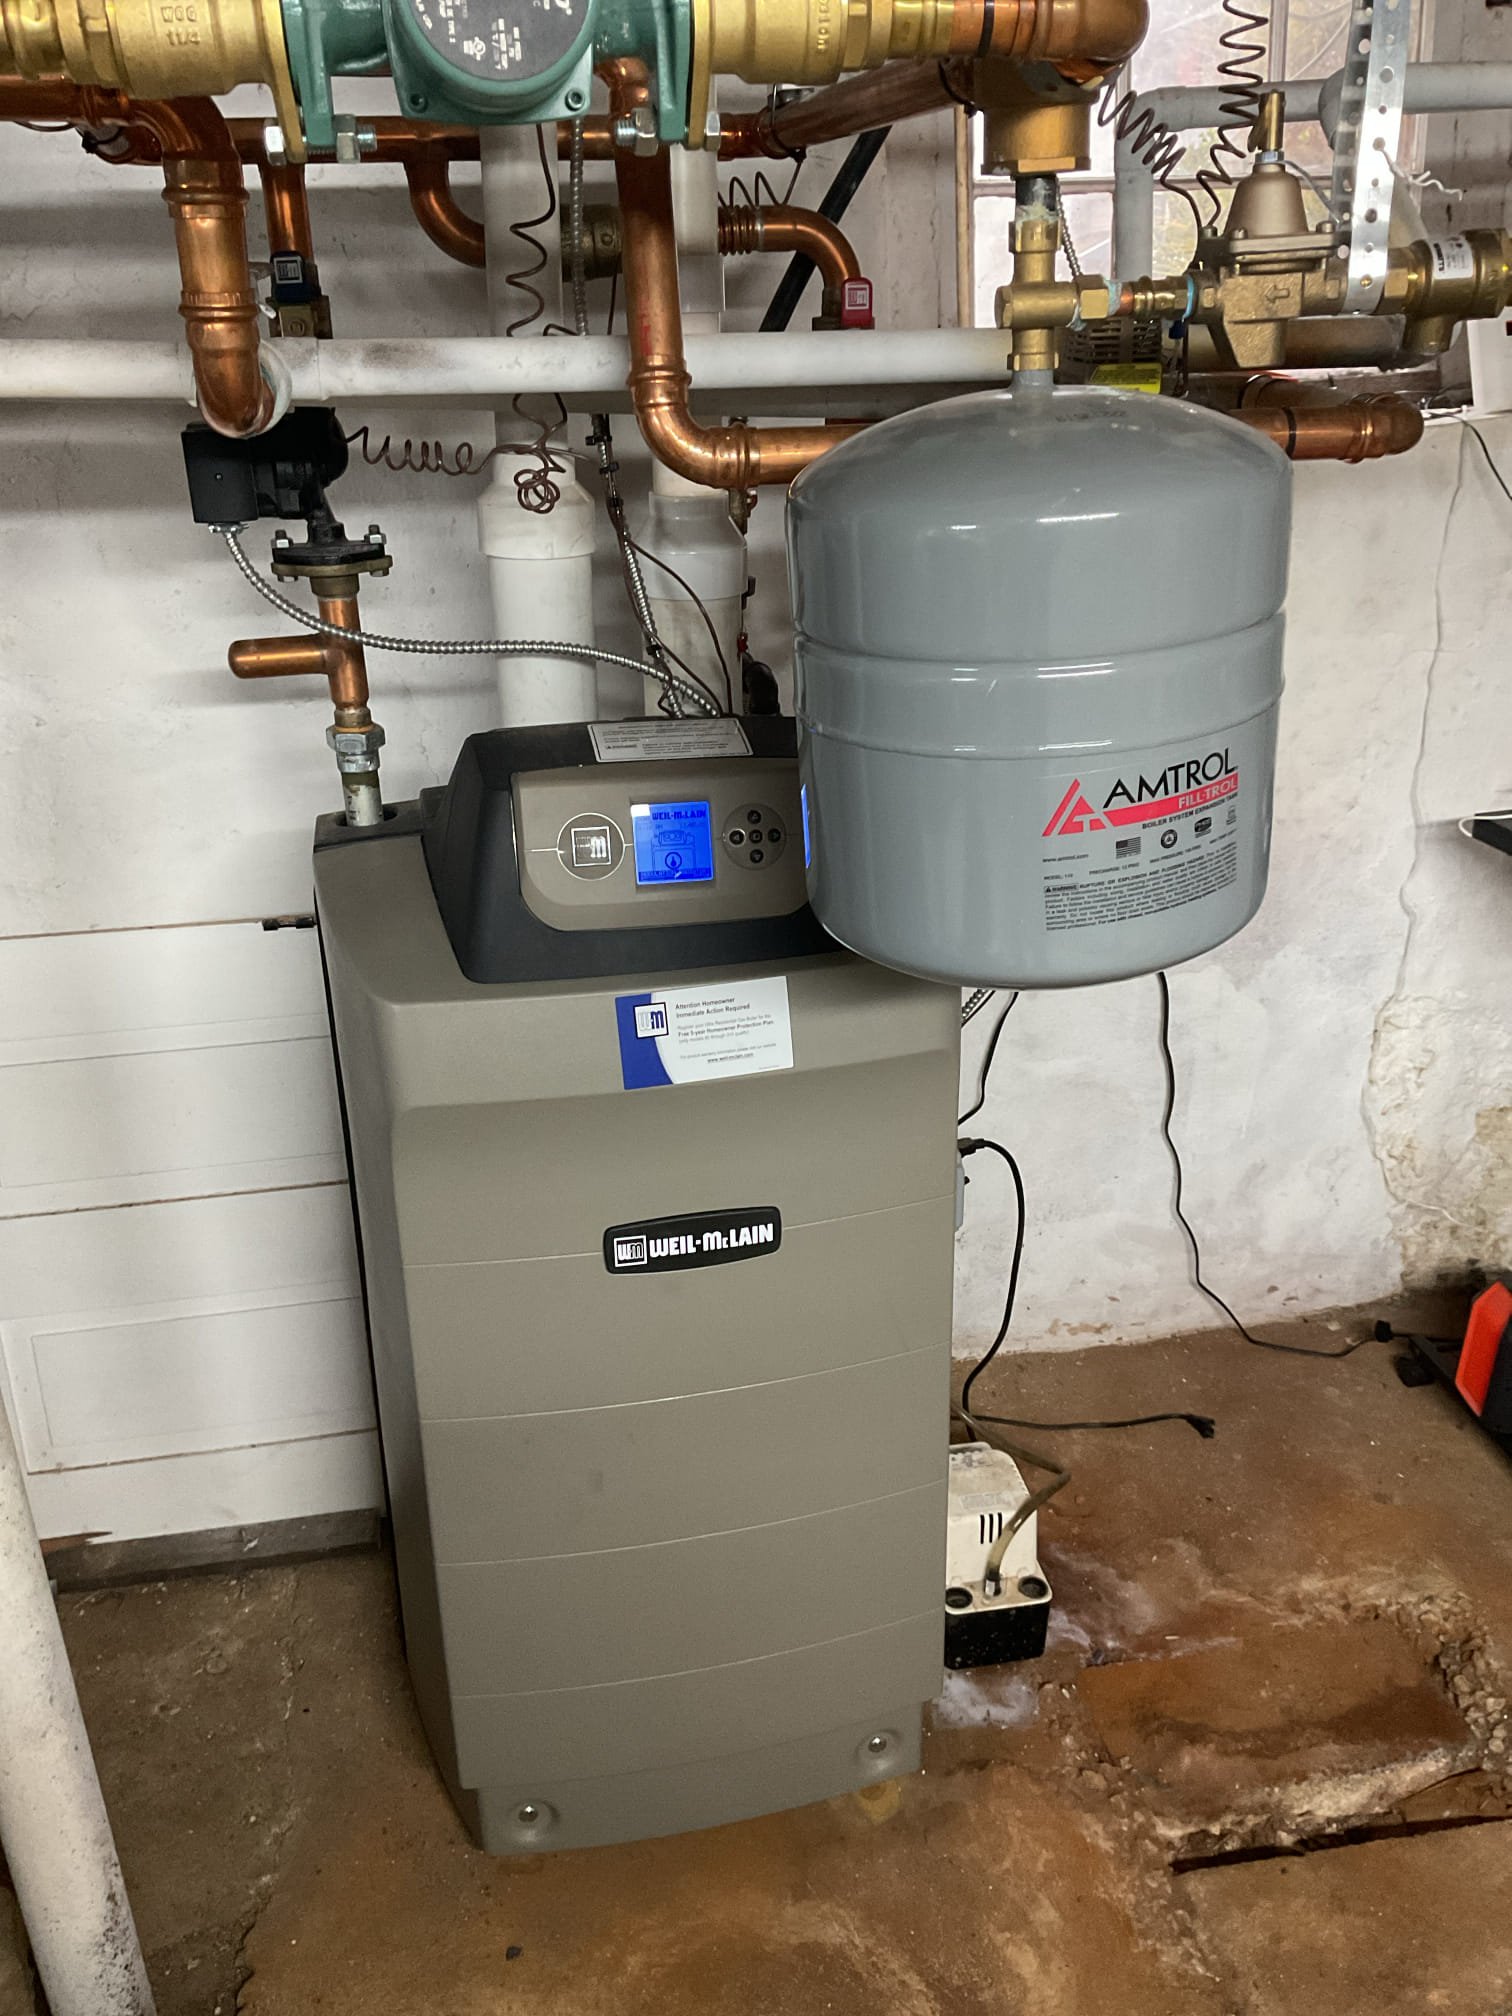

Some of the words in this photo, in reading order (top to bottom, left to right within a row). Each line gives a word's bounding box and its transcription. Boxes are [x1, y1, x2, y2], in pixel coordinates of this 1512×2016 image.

[1103, 747, 1237, 809] AMTROL
[1142, 818, 1167, 829] BOILER
[1169, 810, 1194, 823] SYSTEM
[675, 1002, 700, 1010] Attention
[702, 998, 735, 1006] Homeowner
[676, 1010, 705, 1018] Immediate
[725, 1003, 750, 1013] Required
[650, 1223, 774, 1258] WEIL-McLAIN
